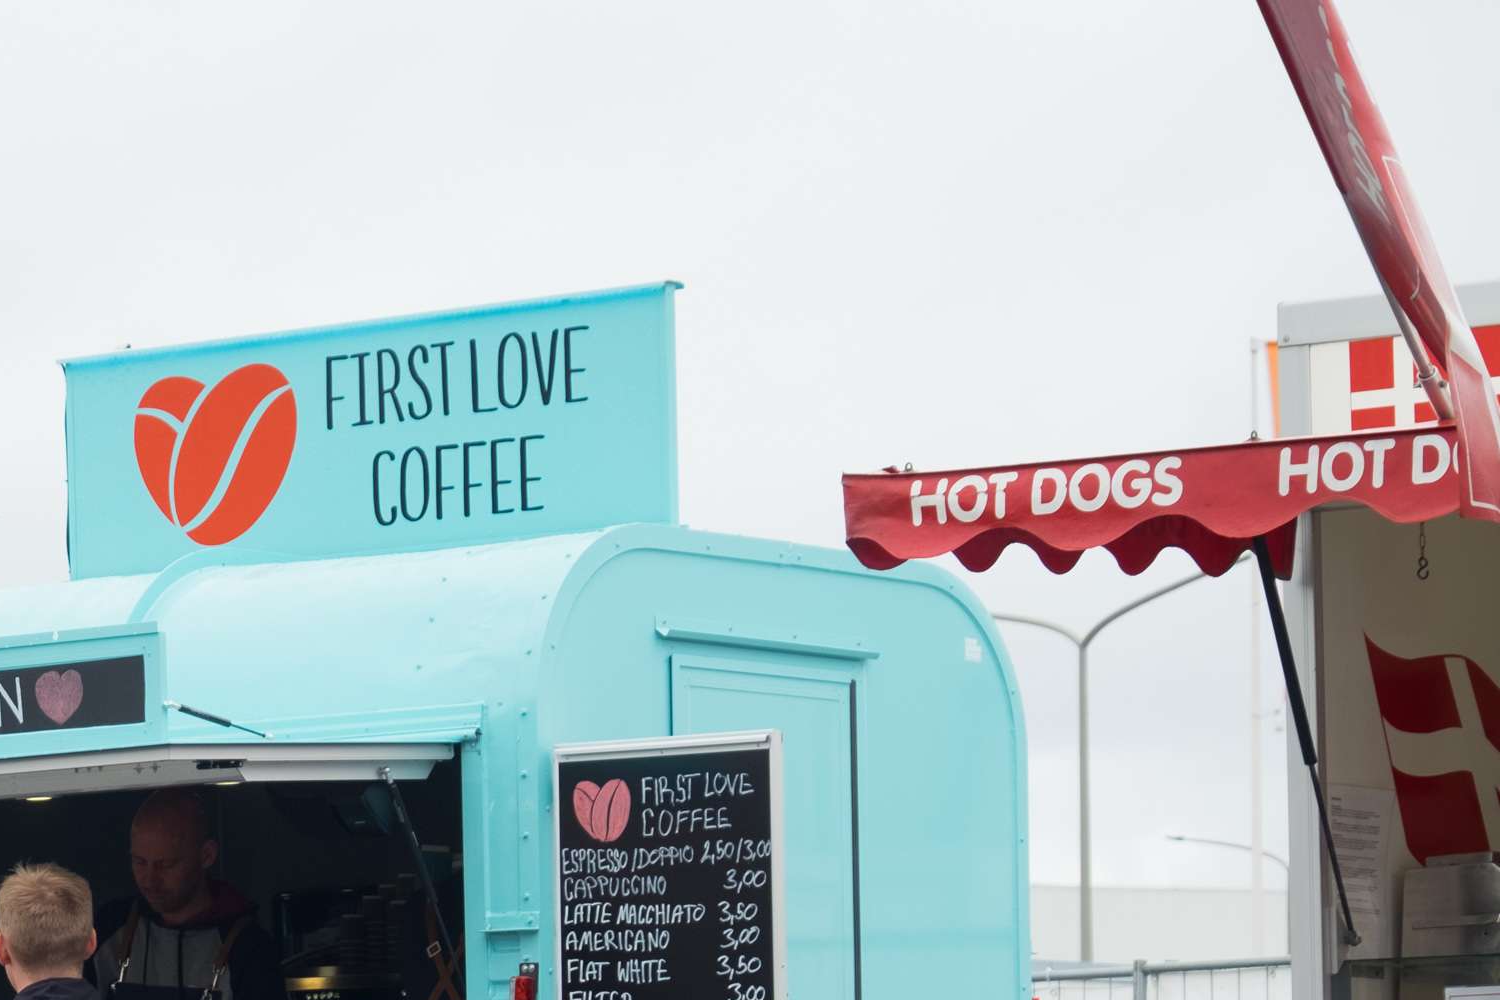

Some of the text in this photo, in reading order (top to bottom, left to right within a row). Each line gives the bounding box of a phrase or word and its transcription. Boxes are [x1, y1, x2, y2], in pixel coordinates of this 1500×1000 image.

[326, 325, 590, 430] FIRST LOVE
[372, 435, 545, 527] COFFEE
[1278, 437, 1396, 497] HOT
[910, 456, 1184, 527] HOT DOGS
[641, 772, 755, 807] FIRST LOVE
[641, 806, 732, 838] COFFEE
[564, 868, 767, 901] CAPPUCCINO 3,00
[564, 900, 758, 926] LATTE MACCHIATO 3,50
[565, 925, 761, 953] AMERICANO 3,00
[566, 954, 762, 985] FLAT WHITE 3,50
